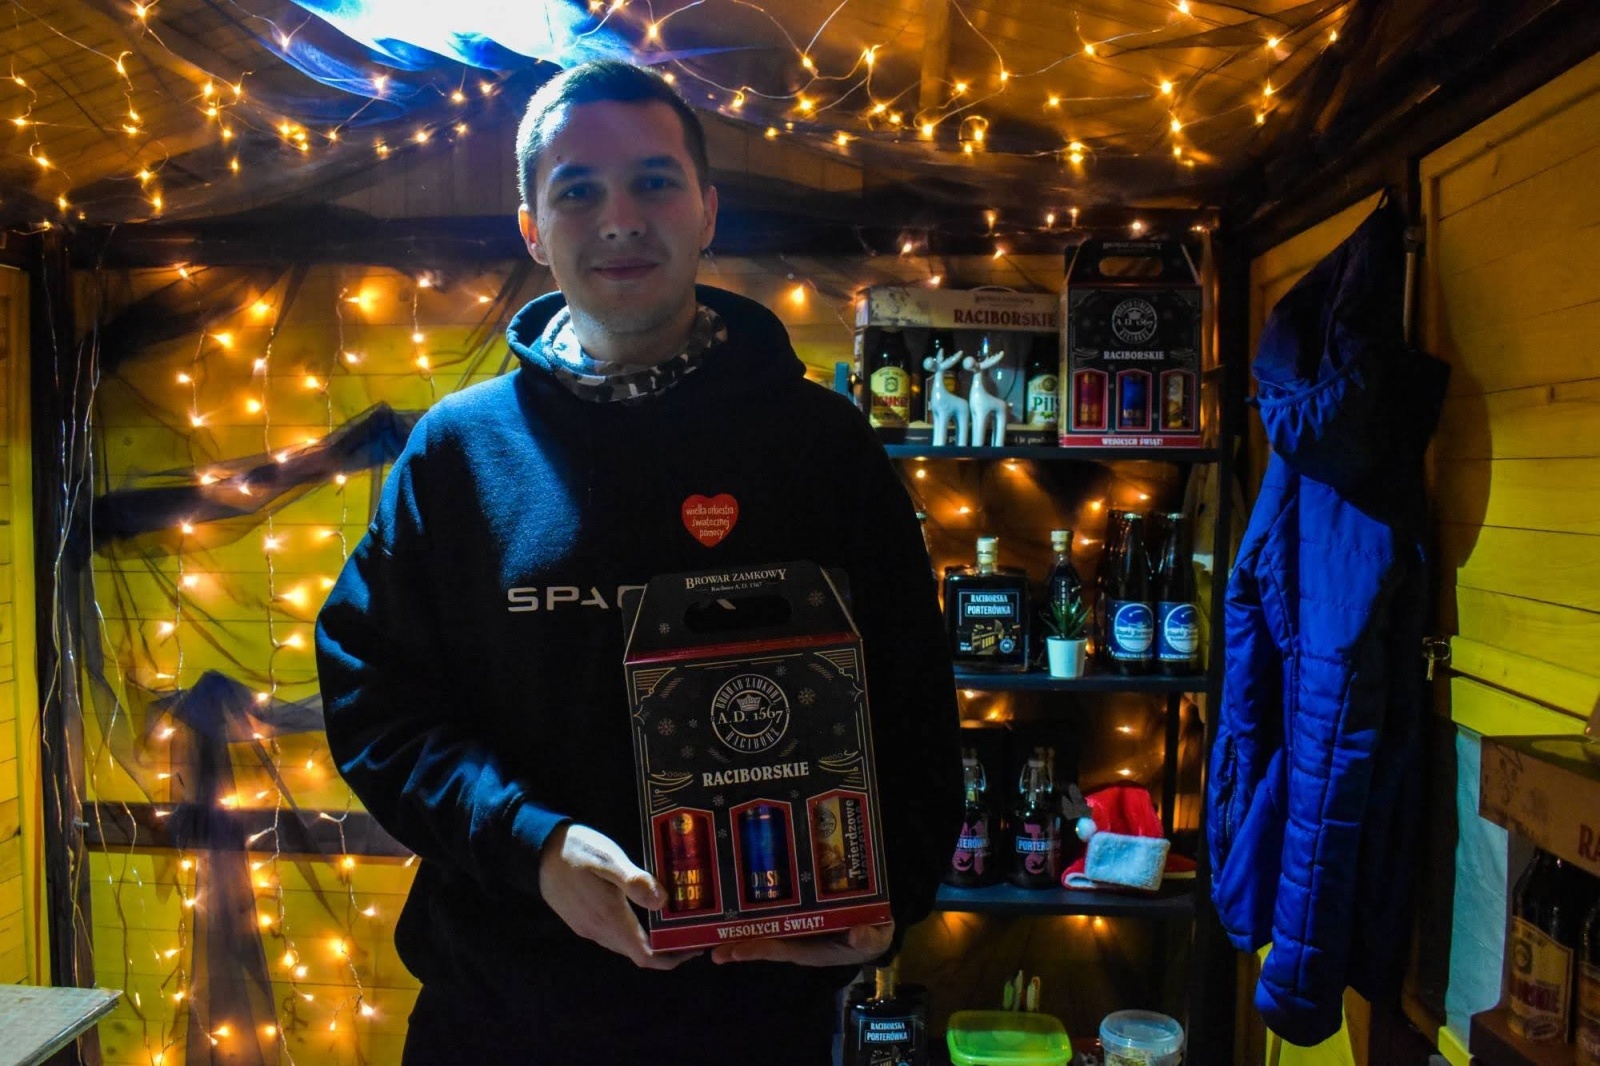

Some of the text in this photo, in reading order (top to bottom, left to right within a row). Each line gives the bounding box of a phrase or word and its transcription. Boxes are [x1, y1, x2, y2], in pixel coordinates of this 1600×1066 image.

[954, 309, 1056, 327] RACIBORSKIE
[1103, 350, 1165, 360] RACIBORSKIE
[686, 503, 707, 515] wielka
[699, 529, 725, 540] pomocy
[685, 568, 787, 589] BROWAR ZAMKOWY
[967, 604, 1011, 615] PORTERÓWKA
[753, 703, 784, 724] 1567
[702, 762, 809, 787] RACIBORSKIE
[845, 799, 861, 879] Twierdzowe
[717, 915, 825, 939] WESOŁYCH ŚWIĄT!
[866, 1030, 908, 1041] PORTERÓWKA
